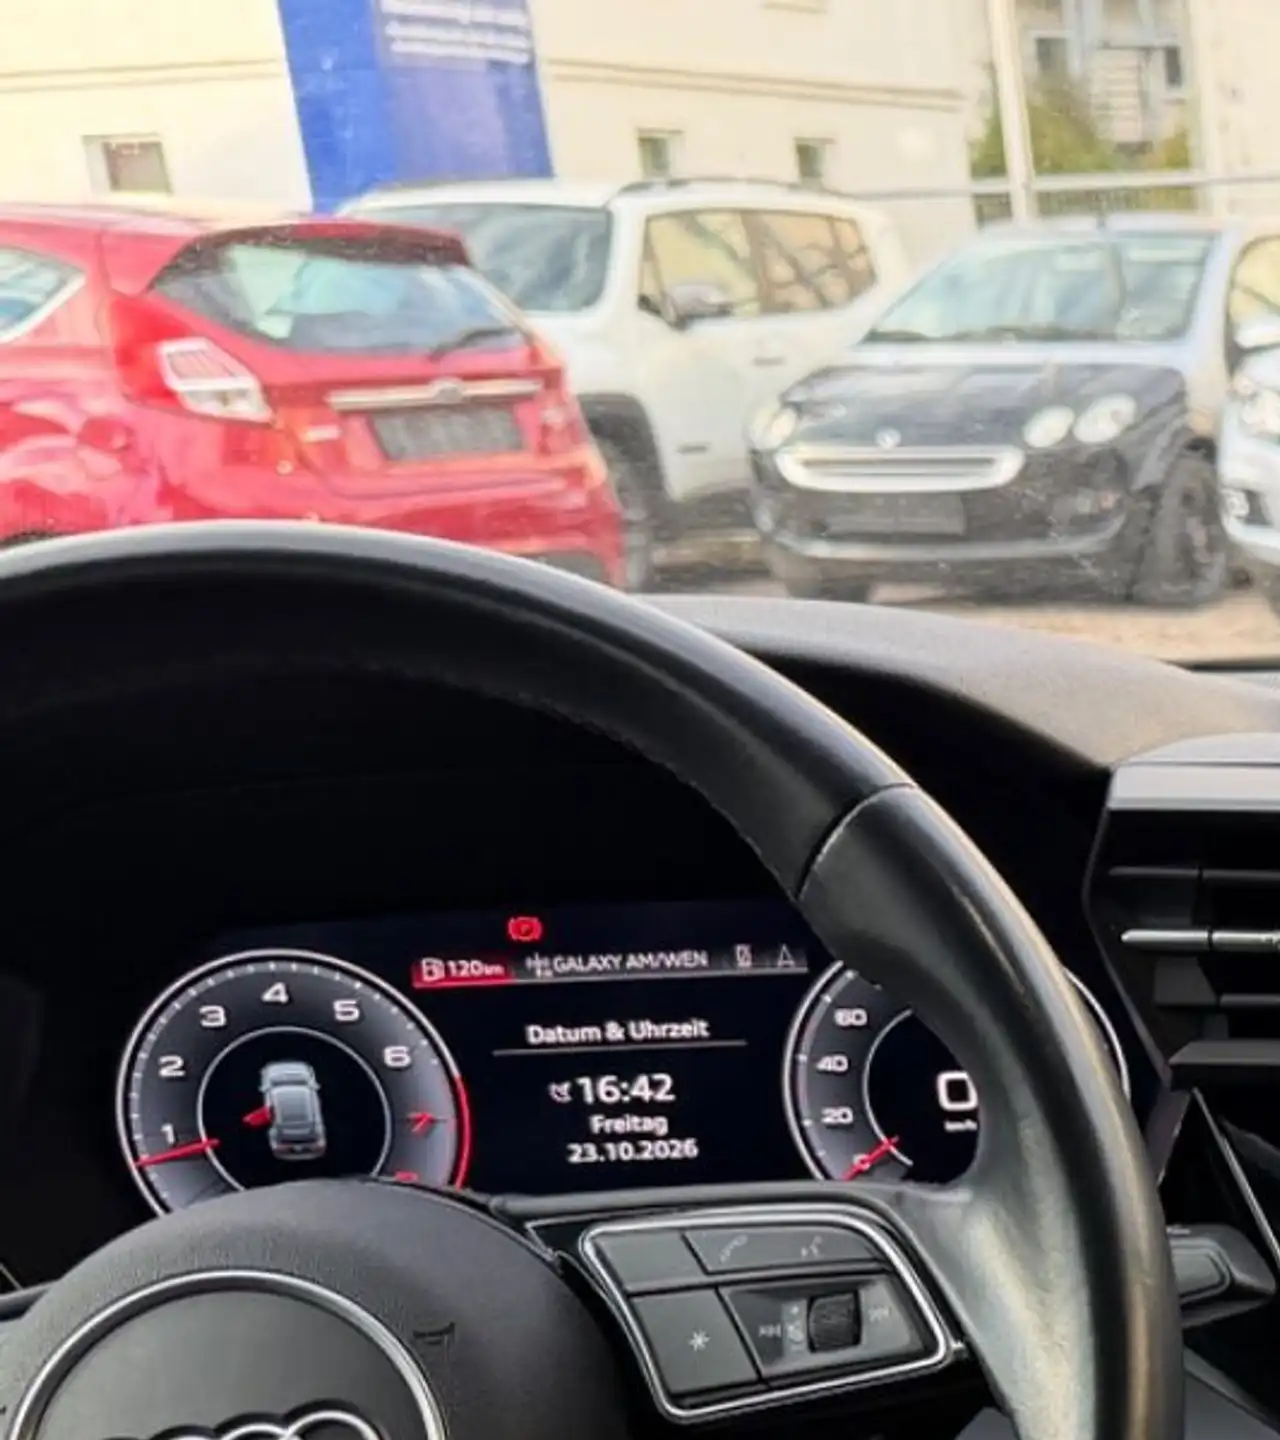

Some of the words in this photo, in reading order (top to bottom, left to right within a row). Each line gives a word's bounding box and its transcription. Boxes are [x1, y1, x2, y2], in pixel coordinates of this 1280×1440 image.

[553, 953, 621, 974] GALAXY
[626, 950, 709, 971] AM/WEN
[261, 982, 289, 1004] 4
[200, 1005, 227, 1027] 3
[333, 999, 360, 1022] 5
[834, 1008, 868, 1026] 60
[526, 1023, 601, 1045] Datum
[606, 1022, 624, 1041] &
[629, 1018, 710, 1041] Uhrzeit
[158, 1055, 185, 1078] 2
[383, 1046, 411, 1068] 6
[817, 1055, 849, 1073] 40
[577, 1073, 676, 1104] 16:42
[937, 1070, 979, 1111] 0
[590, 1114, 669, 1137] Freitag
[821, 1106, 853, 1125] 20
[161, 1122, 175, 1144] 1
[567, 1138, 699, 1164] 23.10.2026
